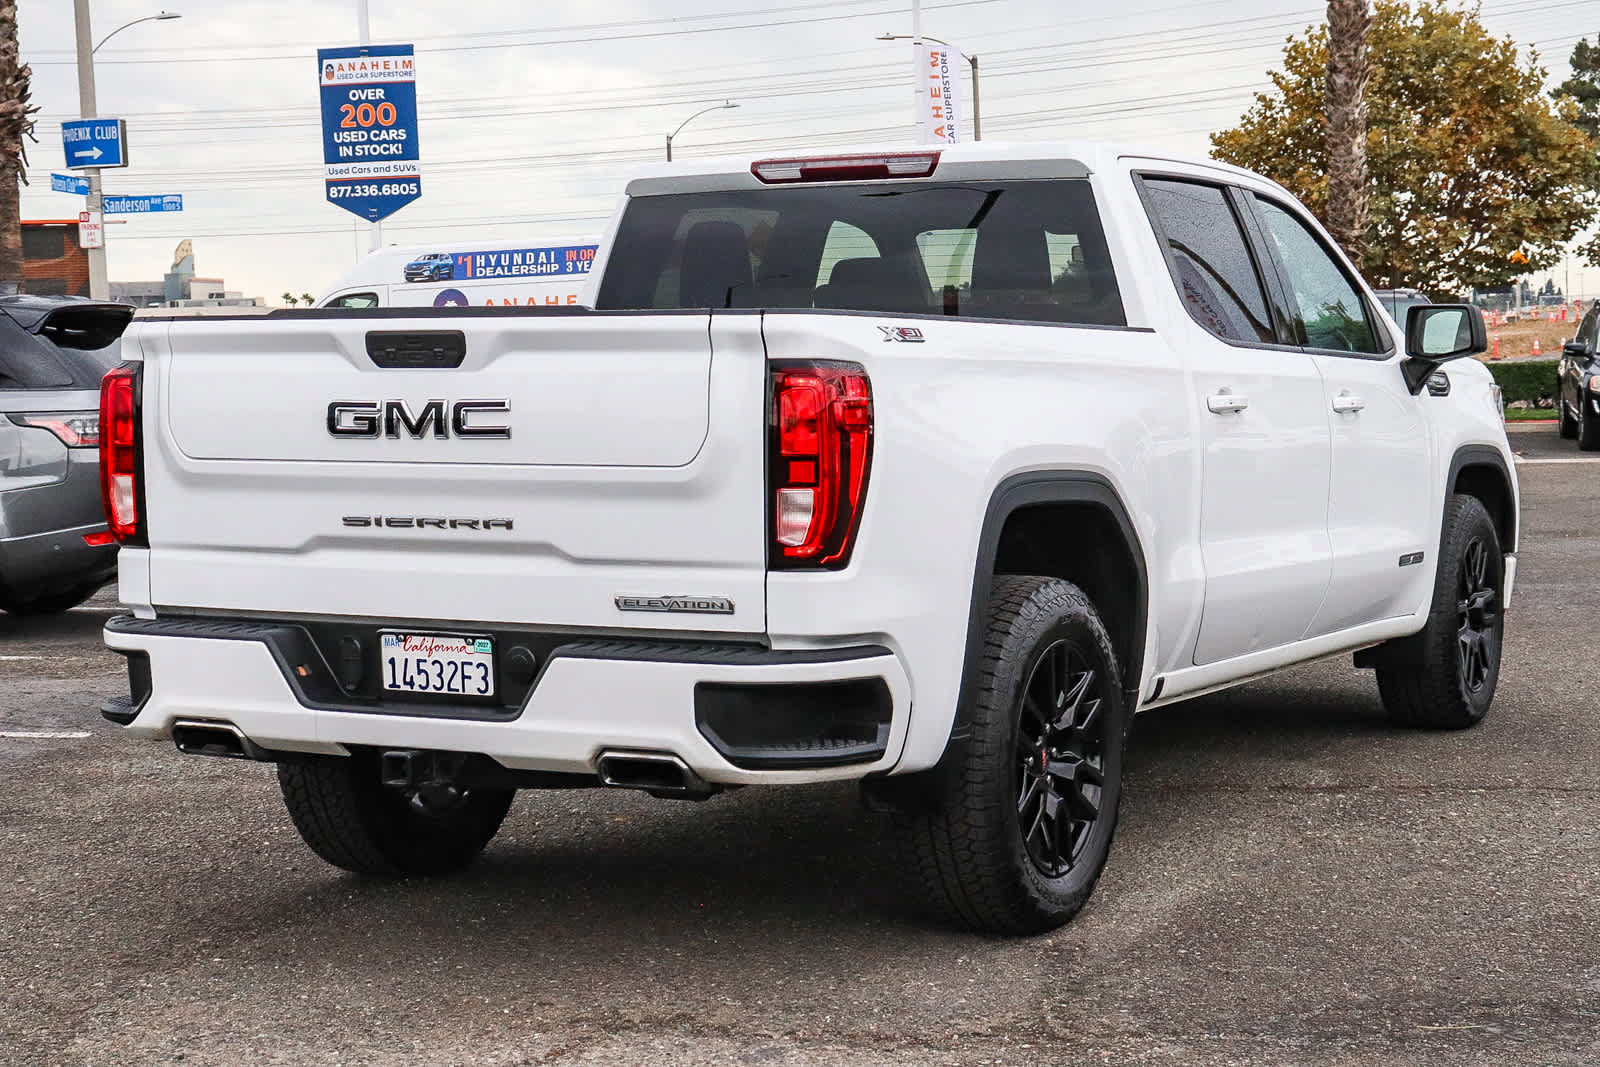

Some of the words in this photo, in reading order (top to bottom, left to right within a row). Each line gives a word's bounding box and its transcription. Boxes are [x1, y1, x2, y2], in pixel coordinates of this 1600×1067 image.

[336, 59, 413, 72] ANAHEIM
[369, 70, 413, 78] SUPERSTORE
[940, 50, 954, 121] SUPERSTORE
[348, 88, 386, 101] OVER
[929, 51, 946, 139] AHEIM
[339, 102, 397, 128] 200
[63, 127, 92, 142] PHOENIX
[94, 126, 118, 140] CLUB
[333, 131, 368, 144] USED
[369, 129, 407, 142] CARS
[338, 145, 353, 157] IN
[354, 143, 403, 156] STOCK!
[328, 167, 350, 176] Used
[351, 166, 372, 174] Cars
[372, 164, 391, 173] and
[392, 164, 417, 173] SUVs
[329, 183, 418, 199] 877.336.6805
[103, 198, 151, 213] Sanderson
[476, 250, 555, 267] HYUNDAI
[565, 250, 578, 261] IN
[476, 262, 560, 277] DEALERSHIP
[566, 261, 573, 273] 3
[327, 399, 511, 440] GMC
[342, 516, 513, 530] SIERRA
[623, 598, 725, 611] ELEVATION
[403, 635, 475, 658] California
[388, 656, 490, 694] 14532F3
